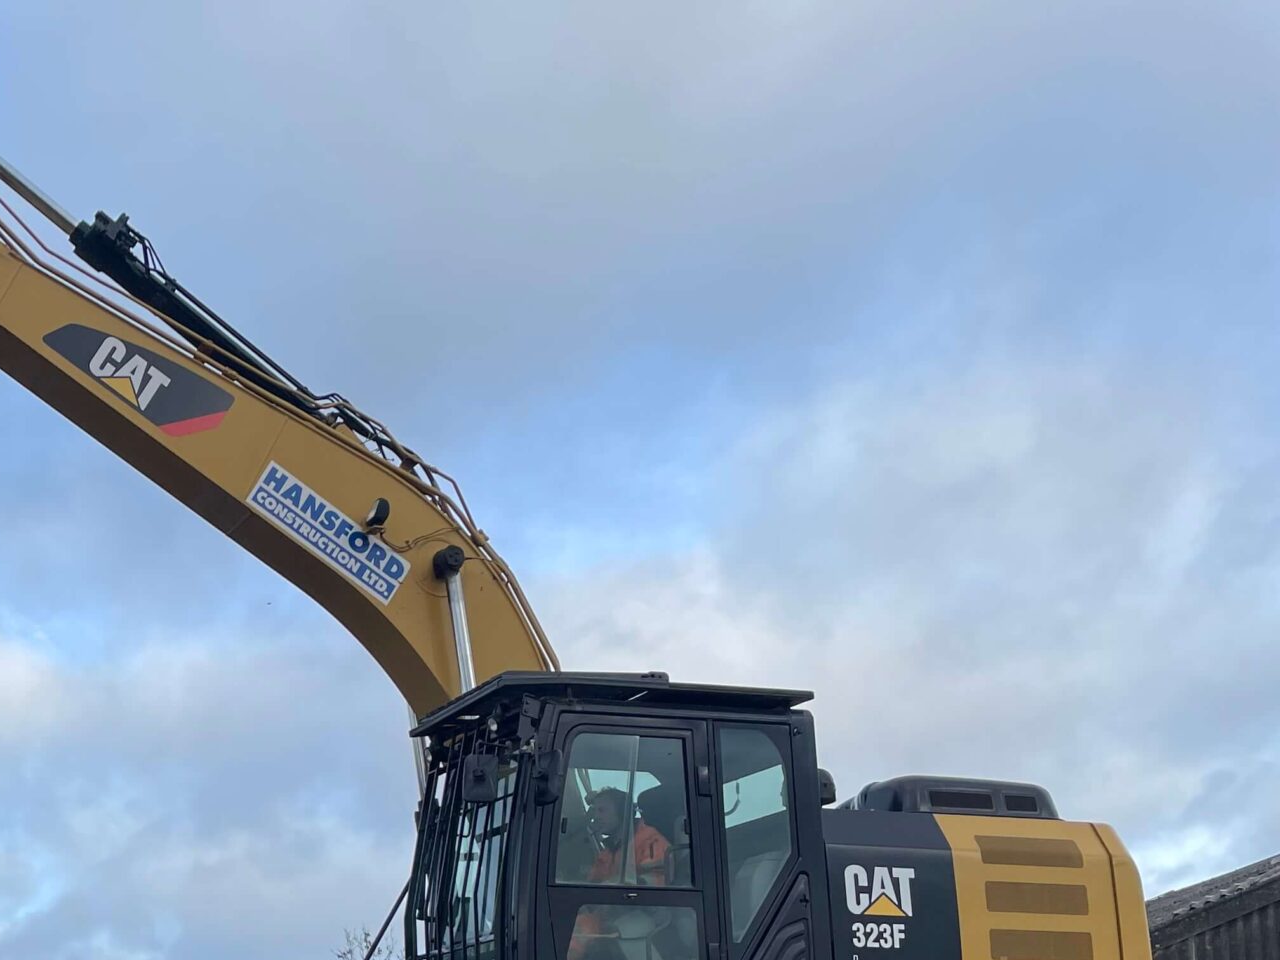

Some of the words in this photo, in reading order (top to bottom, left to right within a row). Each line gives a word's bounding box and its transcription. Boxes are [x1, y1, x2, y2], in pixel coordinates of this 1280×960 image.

[89, 337, 171, 411] CAT
[256, 491, 360, 573] CONSTRUCTION
[361, 568, 390, 597] LTD.
[262, 466, 405, 583] HANSFORD
[844, 864, 915, 917] CAT
[852, 923, 905, 949] 323F
